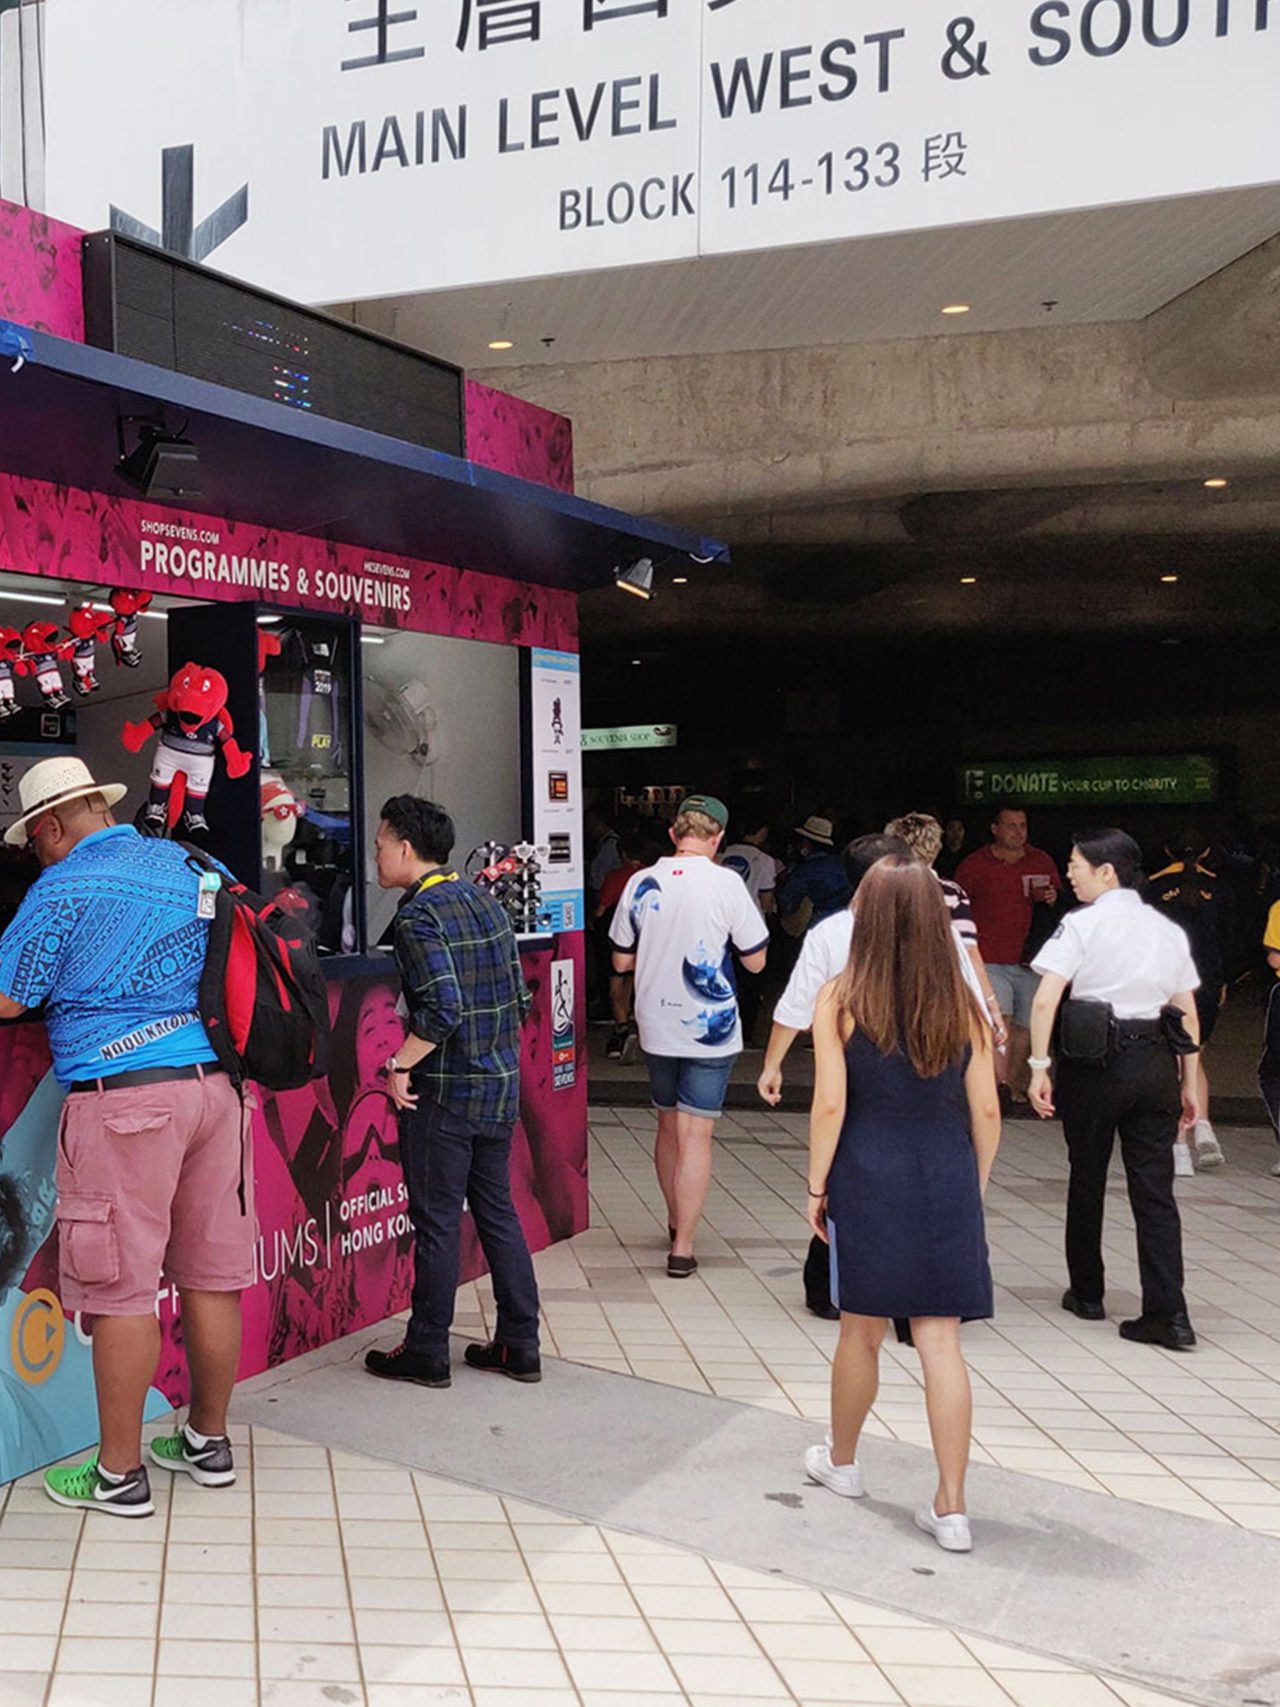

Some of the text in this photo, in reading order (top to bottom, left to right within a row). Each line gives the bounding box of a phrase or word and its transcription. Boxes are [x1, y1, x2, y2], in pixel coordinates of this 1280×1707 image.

[321, 104, 467, 180] MAIN
[498, 73, 677, 154] LEVEL
[710, 28, 906, 119] WEST
[940, 16, 991, 81] &
[559, 131, 968, 231] BLOCK 114-133 段
[140, 519, 220, 545] SHOPSEVENS.COM
[140, 540, 412, 611] PROGRAMMES & SOUVENIRS
[991, 772, 1058, 793] DONATE
[340, 1187, 394, 1221] OFFICIAL
[341, 1221, 384, 1257] HONG
